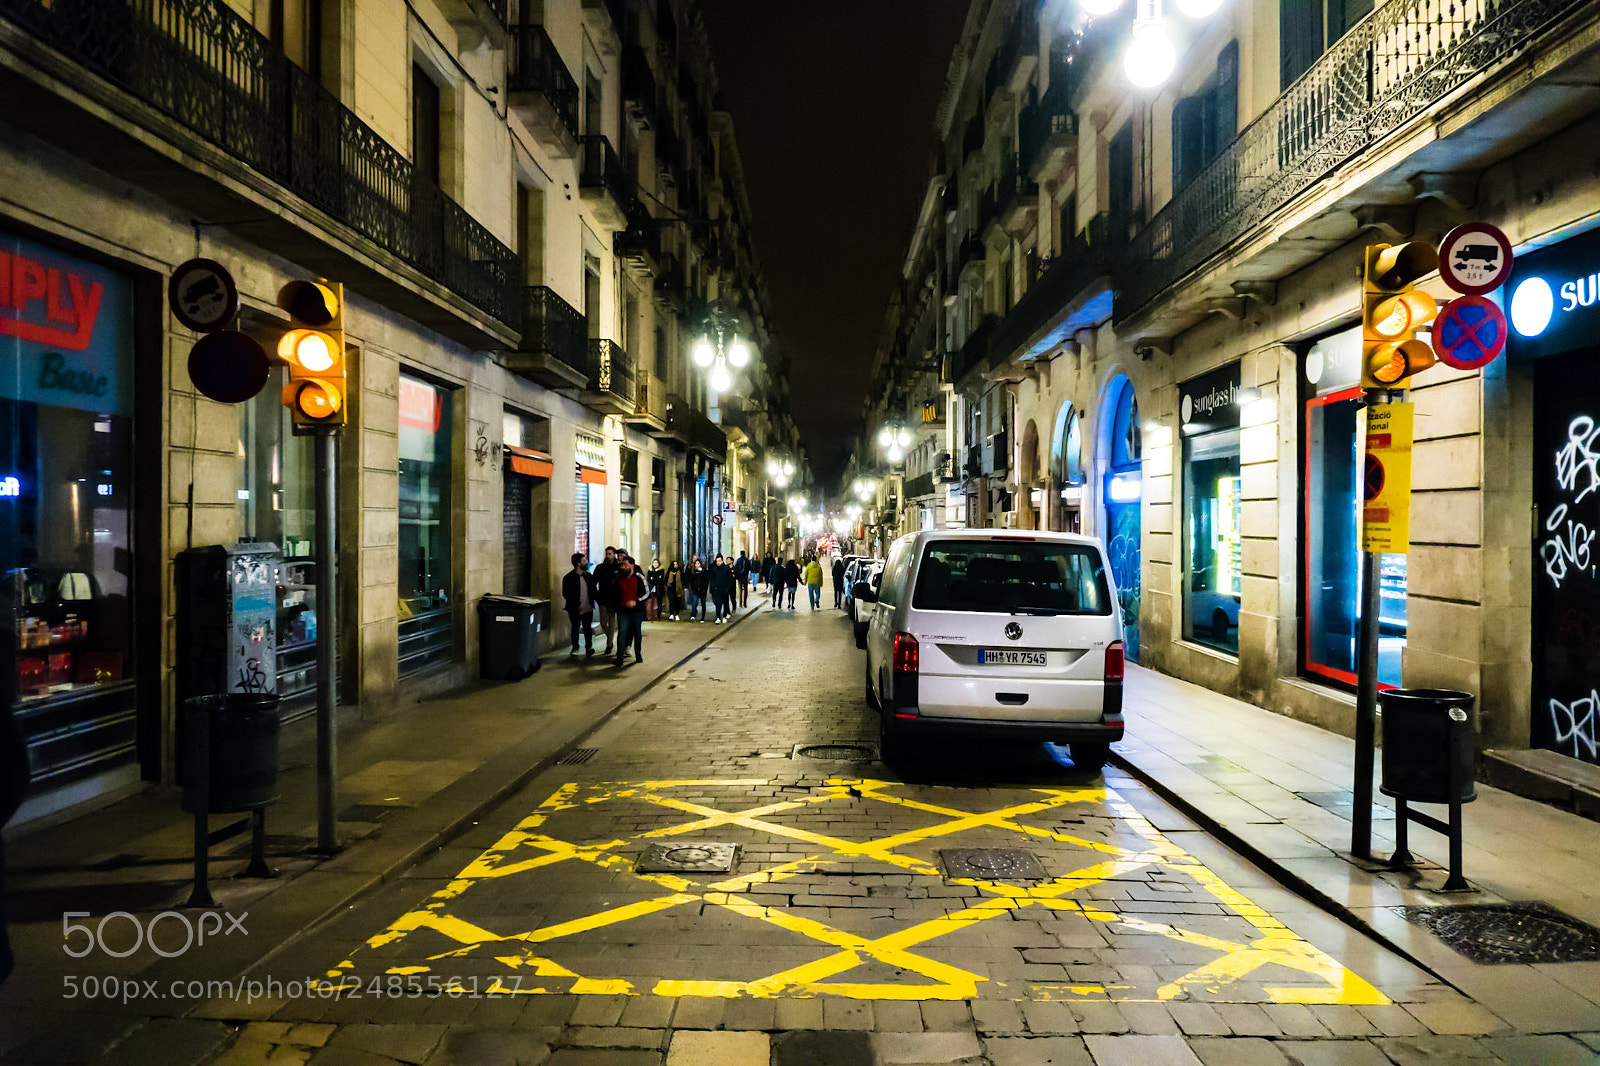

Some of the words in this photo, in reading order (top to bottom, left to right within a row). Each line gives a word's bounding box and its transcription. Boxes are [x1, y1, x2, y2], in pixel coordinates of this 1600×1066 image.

[0, 249, 103, 351] PLY
[1561, 272, 1600, 312] su
[38, 352, 108, 397] Basic
[1194, 387, 1228, 416] sunglass
[985, 652, 998, 662] HH
[1006, 652, 1018, 663] YR
[1020, 653, 1046, 664] 7545
